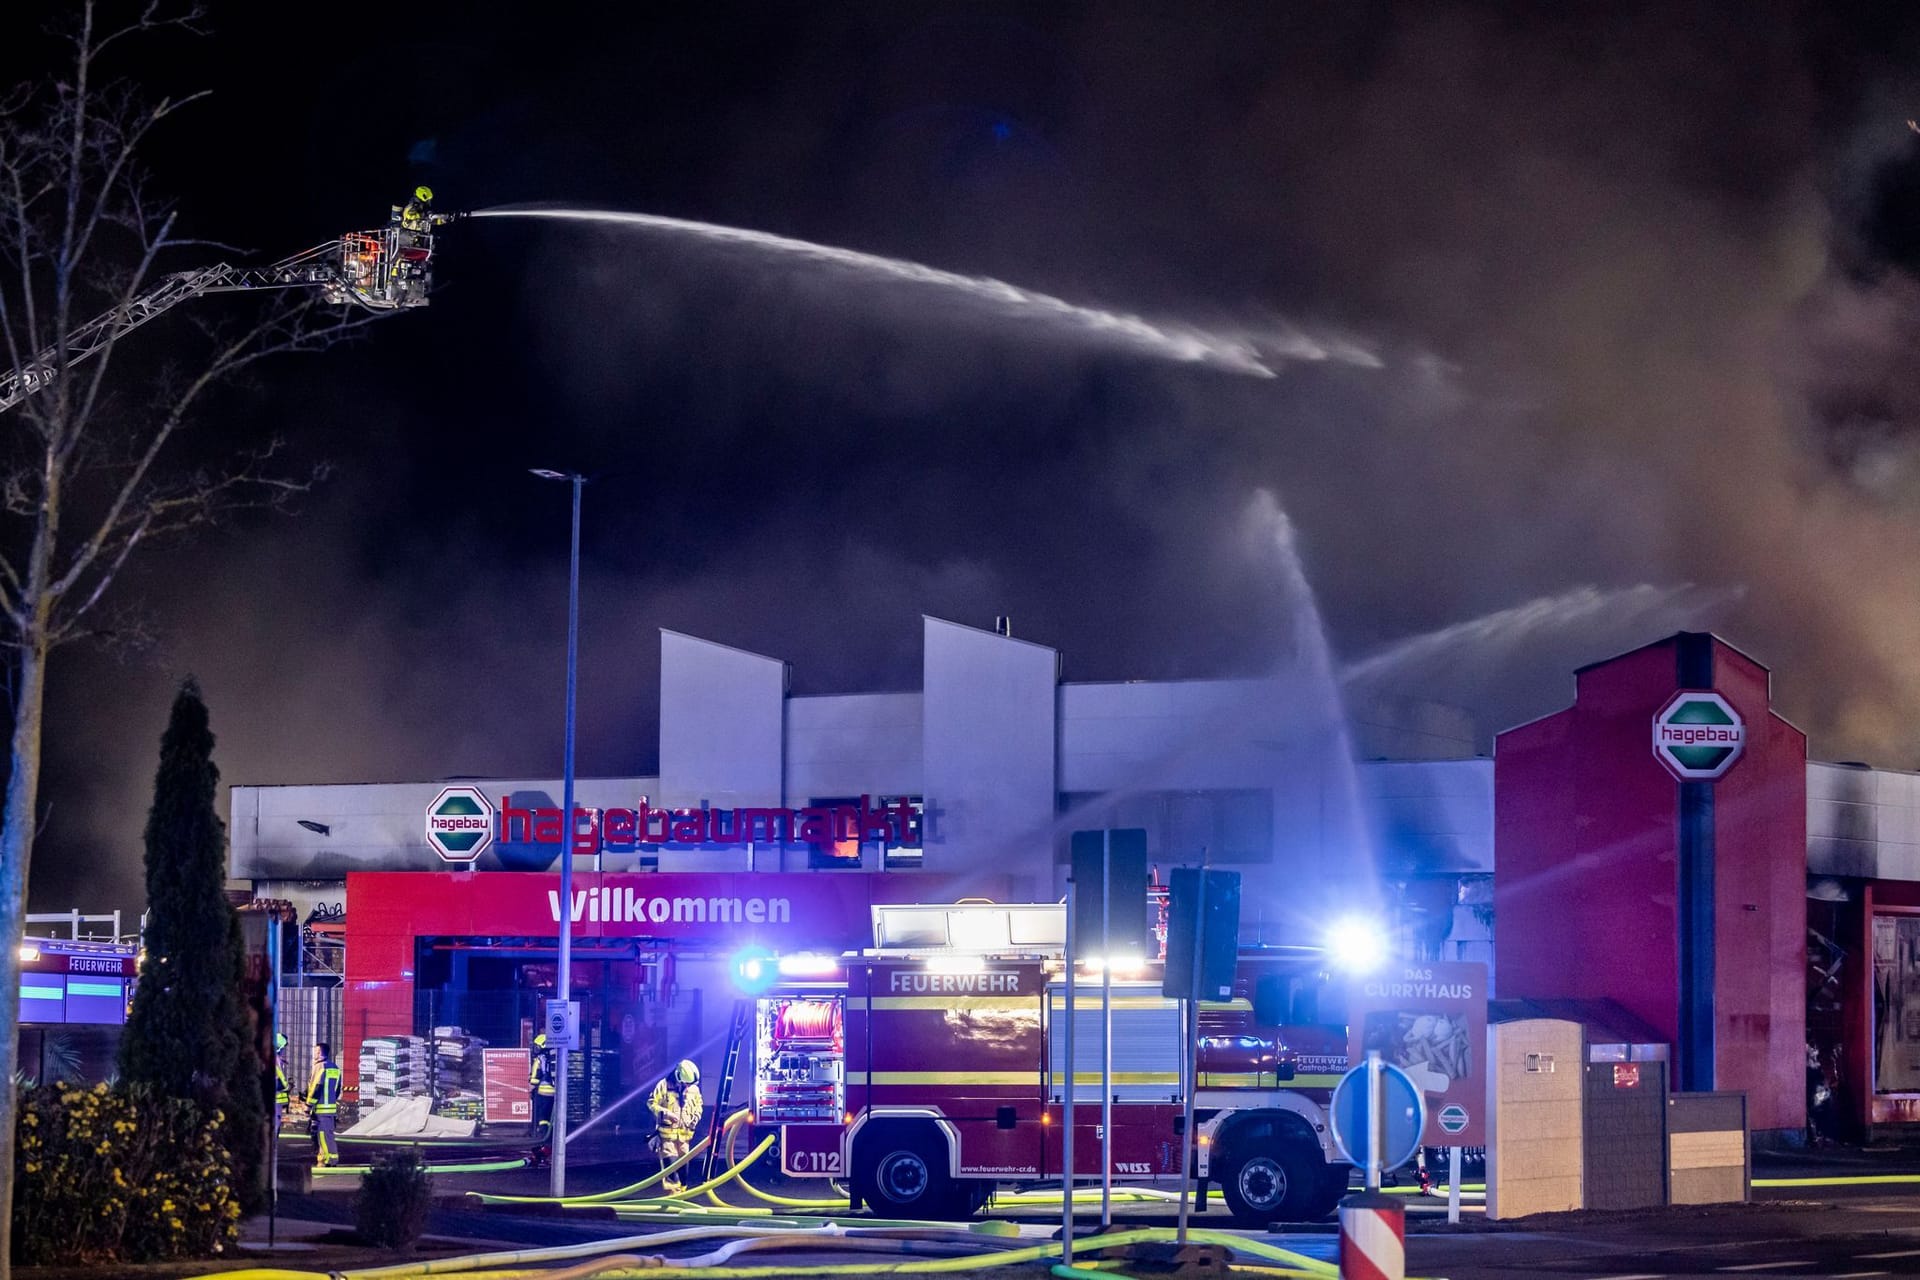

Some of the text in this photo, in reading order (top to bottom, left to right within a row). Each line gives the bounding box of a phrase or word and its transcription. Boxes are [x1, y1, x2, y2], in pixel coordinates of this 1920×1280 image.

[1661, 725, 1740, 744] hagebau
[431, 816, 489, 832] hagebau
[501, 794, 917, 855] hagebaumarkt
[548, 887, 790, 923] Willkommen
[69, 956, 123, 973] FEUERWEHR
[1404, 968, 1433, 980] DAS
[890, 970, 1020, 992] FEUERWEHR
[1363, 983, 1473, 999] CURRYHAUS
[810, 1152, 841, 1172] 112
